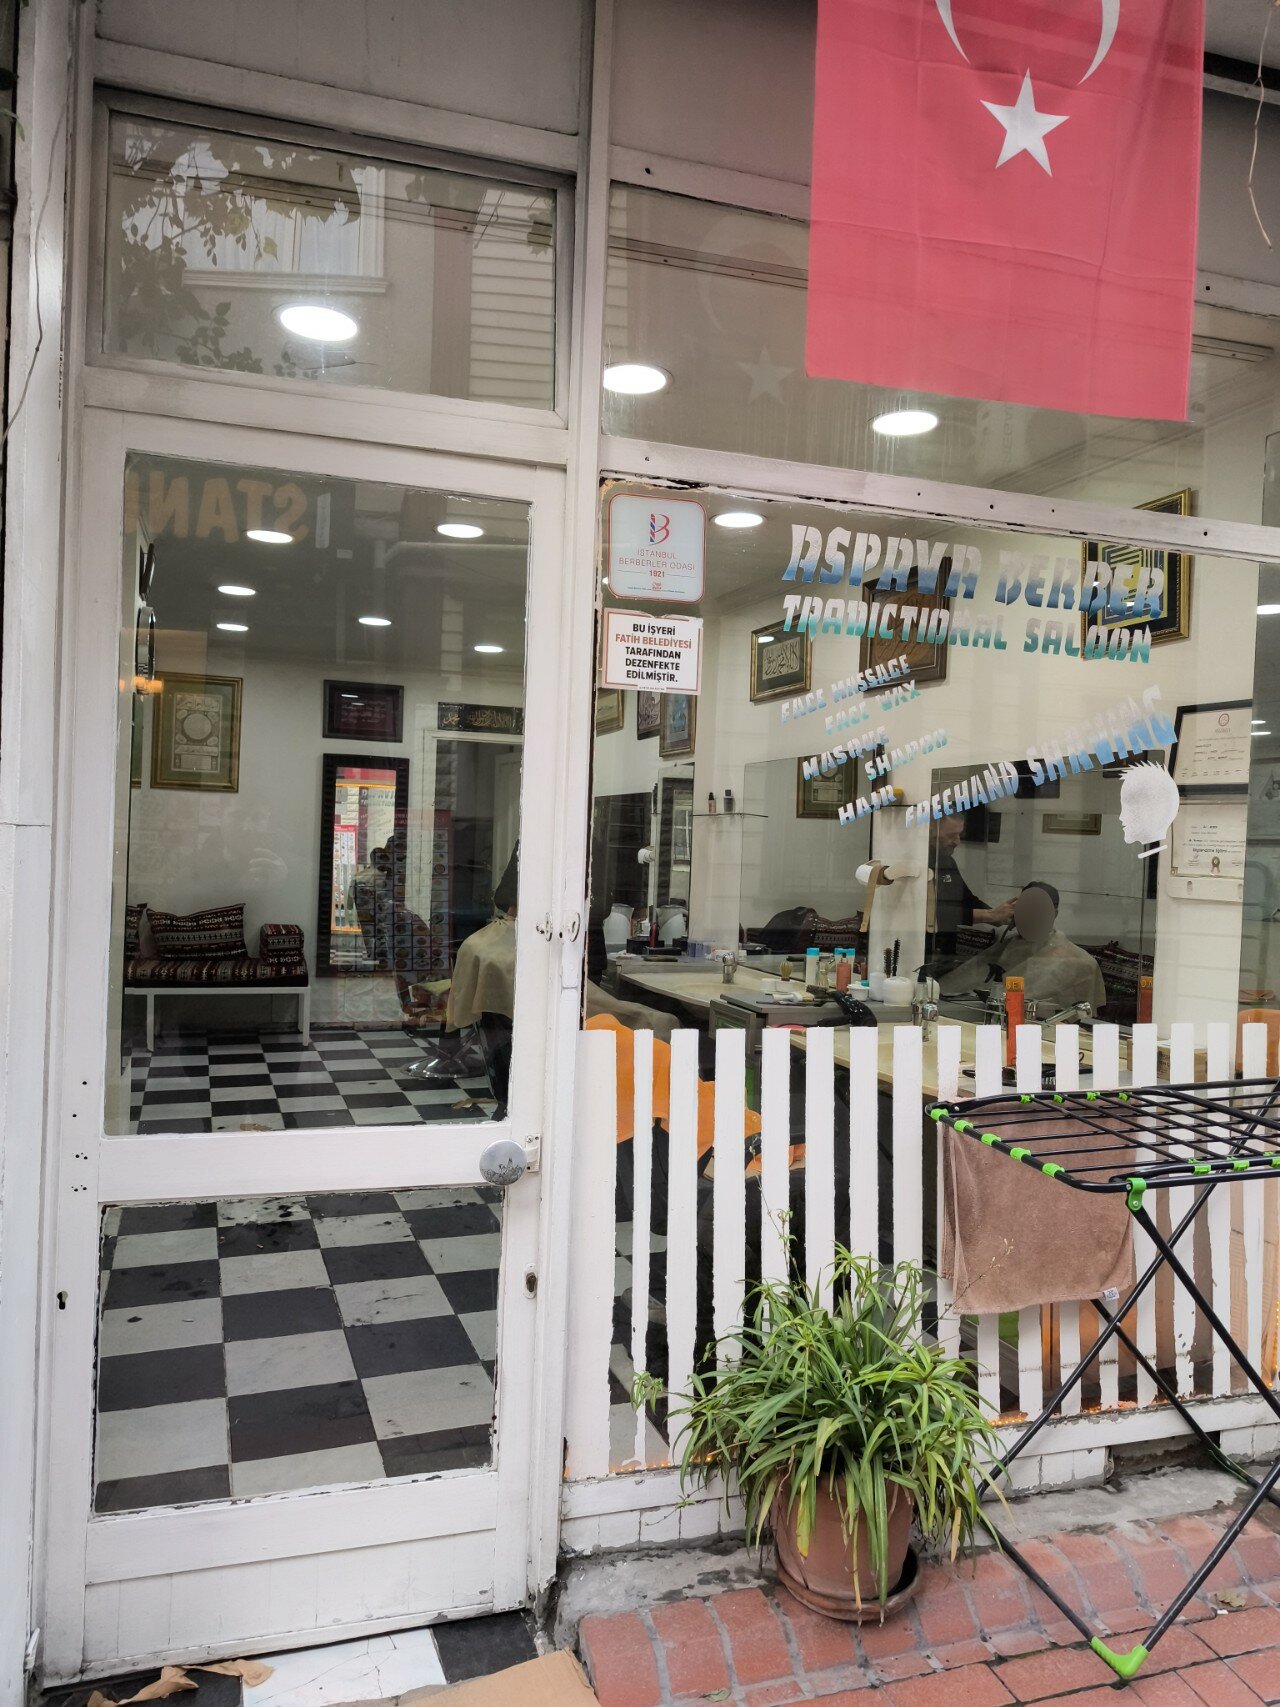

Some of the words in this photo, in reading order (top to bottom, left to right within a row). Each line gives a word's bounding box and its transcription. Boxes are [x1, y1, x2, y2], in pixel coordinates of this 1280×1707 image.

[618, 557, 667, 568] BERBERLER
[669, 561, 695, 571] ODASI
[649, 570, 665, 578] 1921
[781, 524, 981, 599] ASPAVA
[994, 550, 1164, 618] BERBER
[615, 633, 641, 644] FATİH
[642, 636, 692, 649] BELEDİYESİ
[632, 623, 646, 633] BU
[647, 622, 676, 636] İŞYERİ
[783, 595, 1008, 650] TRADICTIONAL
[1023, 617, 1152, 664] SALOON
[625, 646, 681, 660] TARAFINDAN
[625, 658, 680, 671] DEZENFEKTE
[626, 668, 678, 683] EDİLMİŞTİR.
[780, 688, 827, 726] FACE
[831, 654, 911, 703] MASSAGE
[824, 701, 870, 735] FACE
[875, 679, 921, 711] WAX
[802, 725, 889, 781] MASQUE
[905, 760, 1020, 830] FREEHAND
[1026, 684, 1178, 787] SHAVING
[838, 784, 897, 826] HAIR
